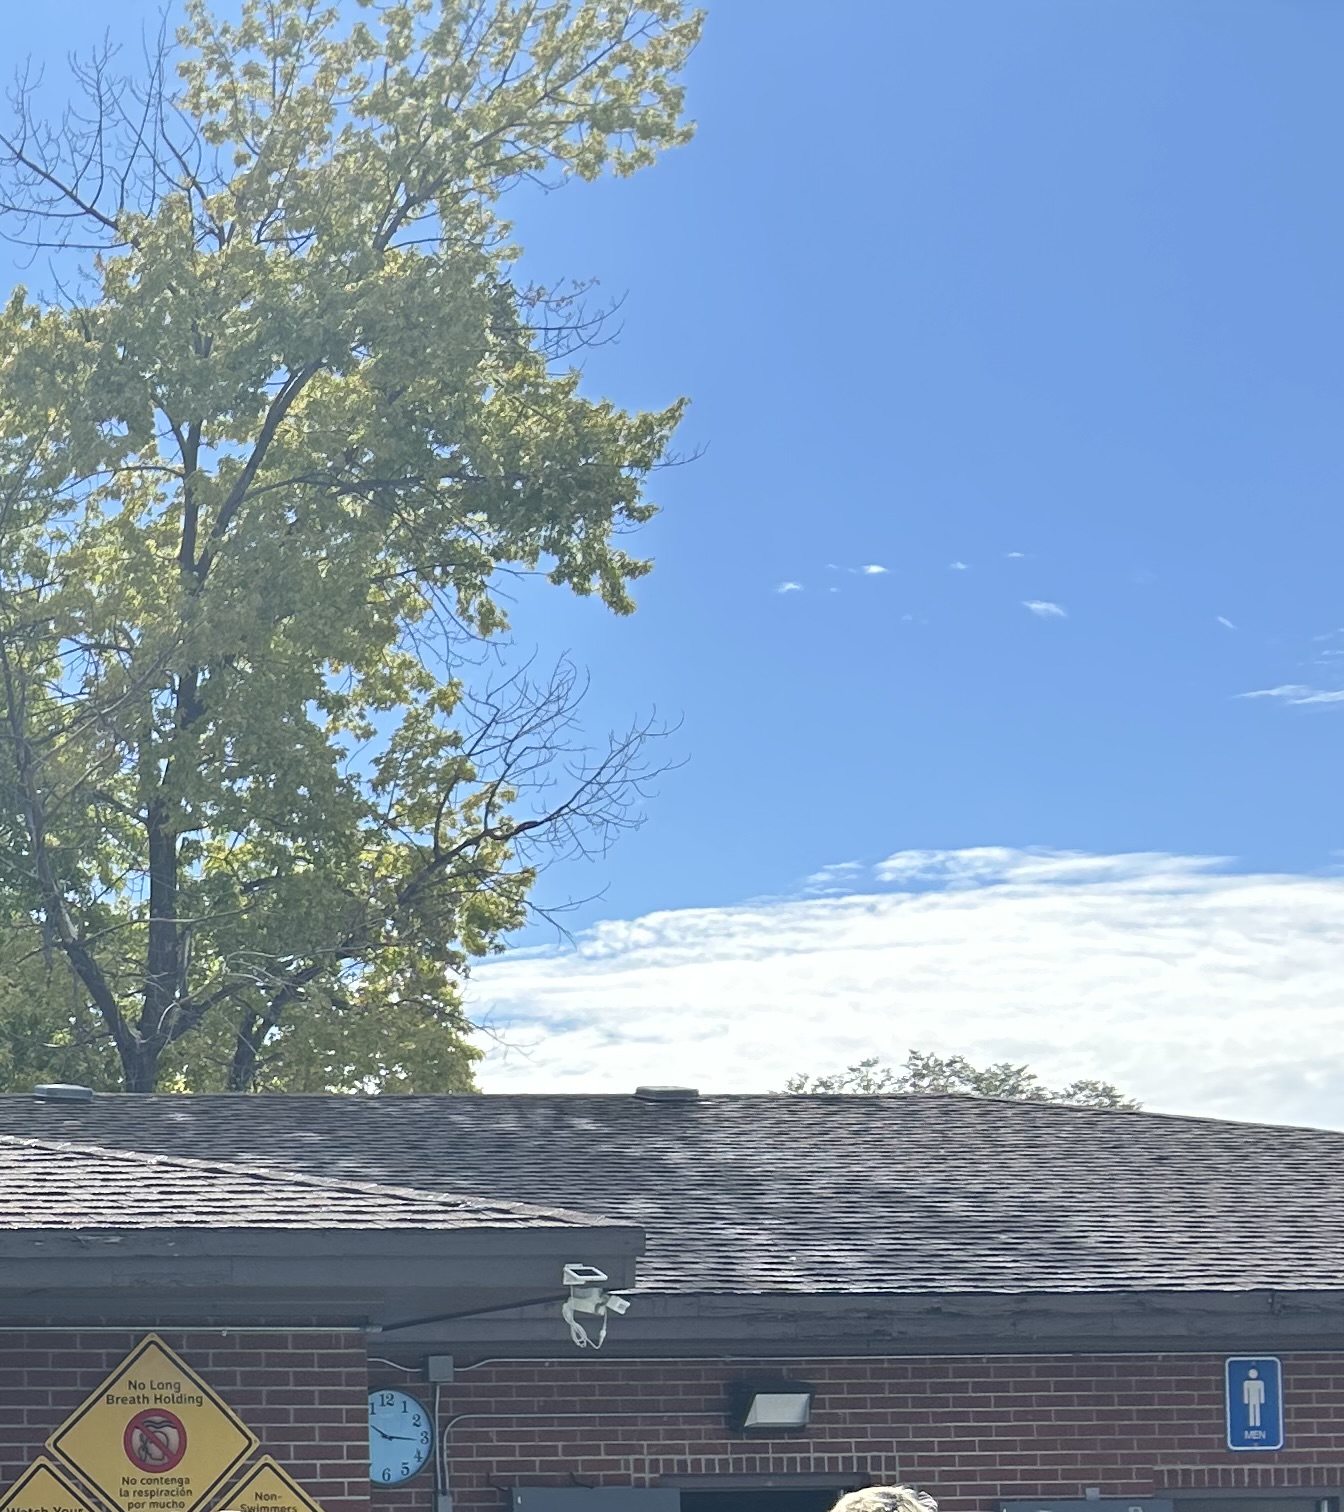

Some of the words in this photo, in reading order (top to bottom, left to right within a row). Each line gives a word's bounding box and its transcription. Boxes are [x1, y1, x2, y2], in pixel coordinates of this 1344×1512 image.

[128, 1380, 145, 1390] No
[150, 1380, 181, 1393] Long
[106, 1394, 149, 1405] Breath
[154, 1394, 203, 1407] Holding
[379, 1390, 395, 1407] 12
[401, 1400, 409, 1414] 1
[412, 1413, 422, 1428] 2
[420, 1430, 429, 1445] 3
[1244, 1430, 1266, 1440] MEN
[413, 1449, 424, 1463] 4
[381, 1467, 391, 1481] 6
[401, 1462, 410, 1476] 5
[121, 1476, 137, 1485] No
[140, 1476, 190, 1487] contenga
[119, 1488, 130, 1497] la
[133, 1487, 193, 1499] respiración
[255, 1492, 282, 1501] Non-
[127, 1501, 145, 1511] por
[149, 1500, 185, 1509] mucho
